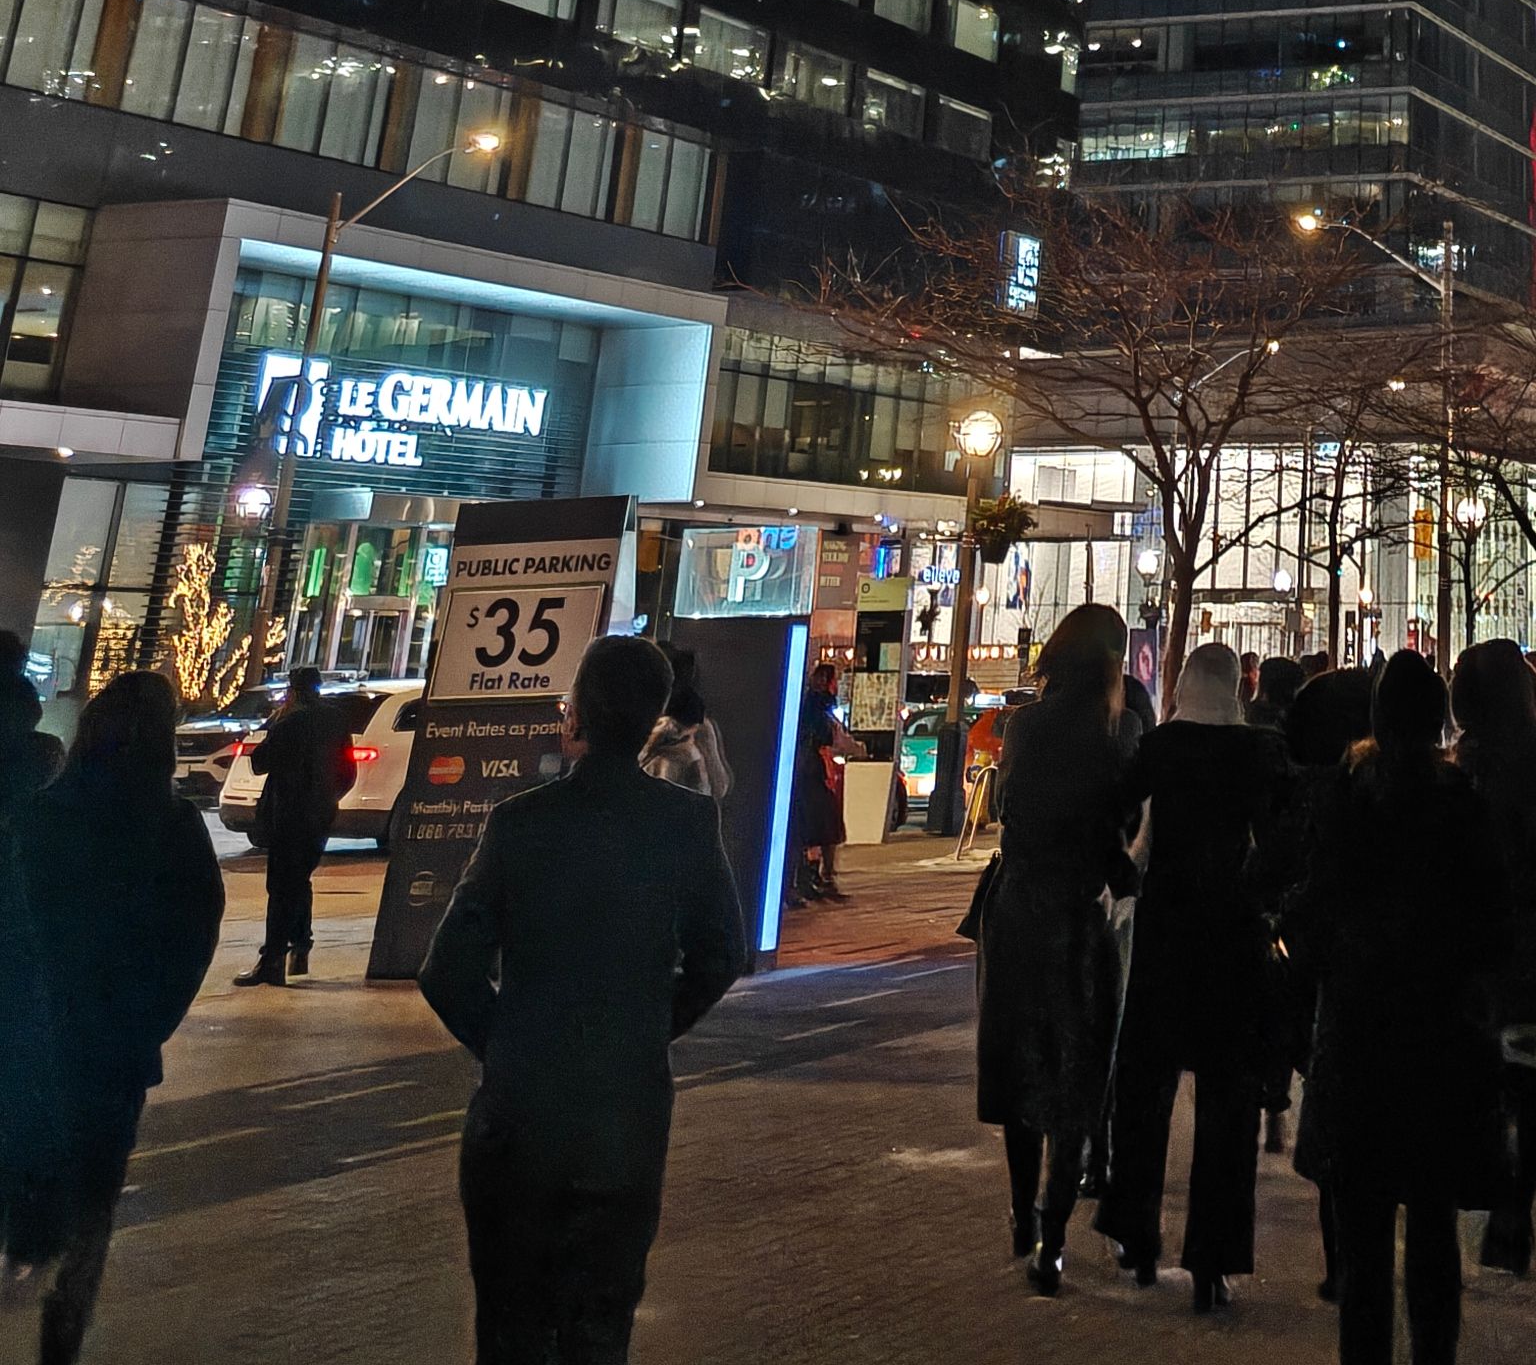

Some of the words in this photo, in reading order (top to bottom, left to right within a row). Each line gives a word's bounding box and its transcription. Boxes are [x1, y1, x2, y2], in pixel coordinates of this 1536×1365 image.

[338, 379, 377, 417] LE
[378, 373, 548, 436] GERMAIN
[331, 420, 423, 466] HÔTEL
[455, 557, 521, 578] PUBLIC
[523, 553, 612, 574] PARKING
[469, 672, 502, 691] Flat
[508, 672, 550, 690] Rate
[426, 721, 462, 739] Event
[466, 721, 506, 737] Rates
[508, 724, 526, 736] as
[481, 759, 521, 778] VISA
[411, 798, 458, 817] Monthly
